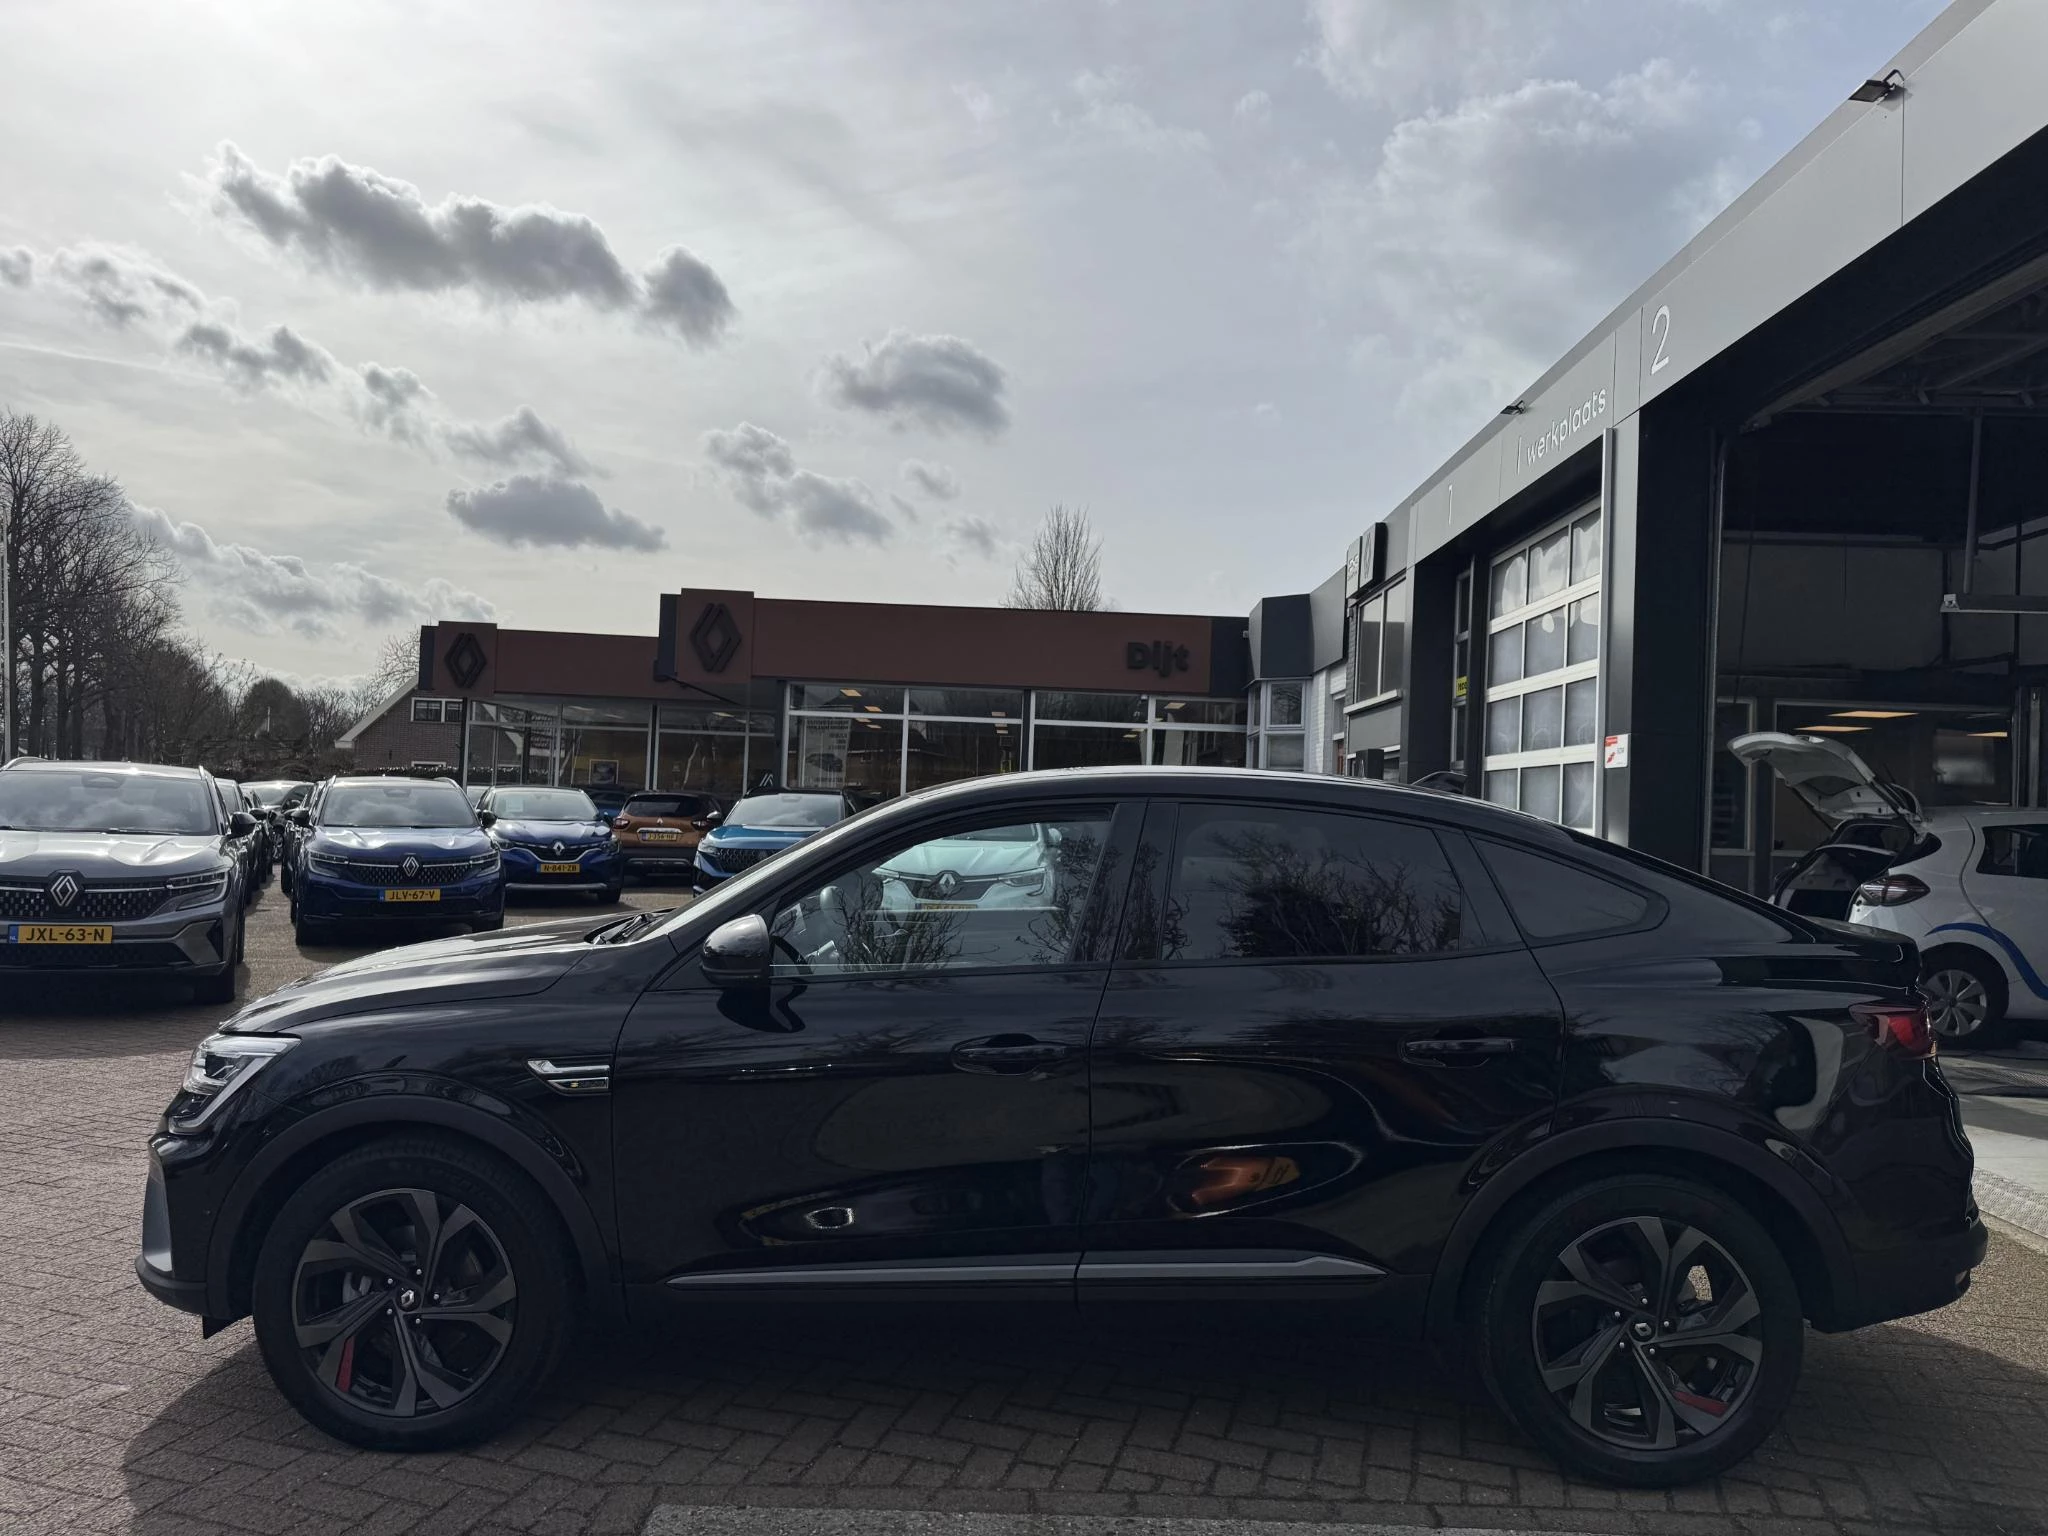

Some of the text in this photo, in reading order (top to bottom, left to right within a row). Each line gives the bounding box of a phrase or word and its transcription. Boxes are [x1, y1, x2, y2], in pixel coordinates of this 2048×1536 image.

[1650, 304, 1671, 375] 2
[1525, 387, 1607, 464] werkplaats
[1126, 640, 1191, 679] Dijt
[388, 890, 436, 900] JLV-67-V
[25, 927, 105, 942] JXL-63-N
